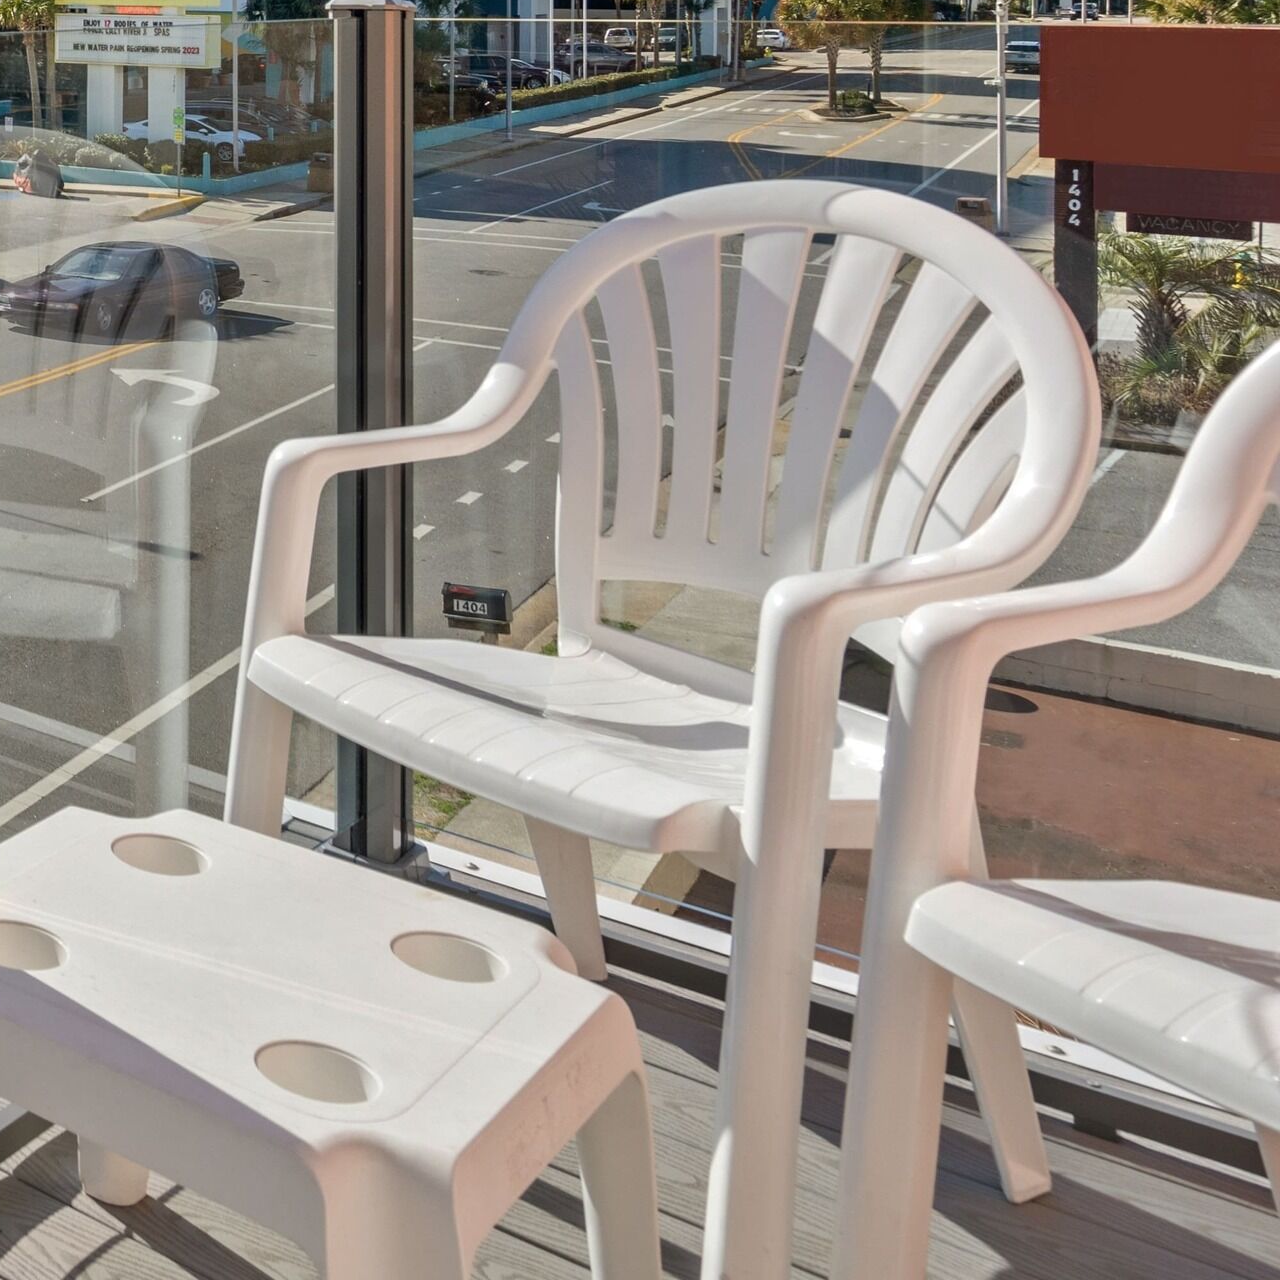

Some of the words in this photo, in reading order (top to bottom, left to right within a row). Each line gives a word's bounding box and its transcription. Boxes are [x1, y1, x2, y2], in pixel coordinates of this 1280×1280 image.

[83, 19, 101, 27] ENJOY
[114, 20, 137, 28] BODIES
[154, 27, 171, 37] SPAS
[73, 43, 85, 51] NEW
[87, 43, 109, 52] WATER
[109, 44, 125, 52] PARK
[160, 45, 181, 55] SPRING
[182, 46, 200, 55] 2023
[1068, 168, 1082, 227] 1404
[1137, 214, 1241, 235] VACANCY
[456, 600, 486, 614] 1404
